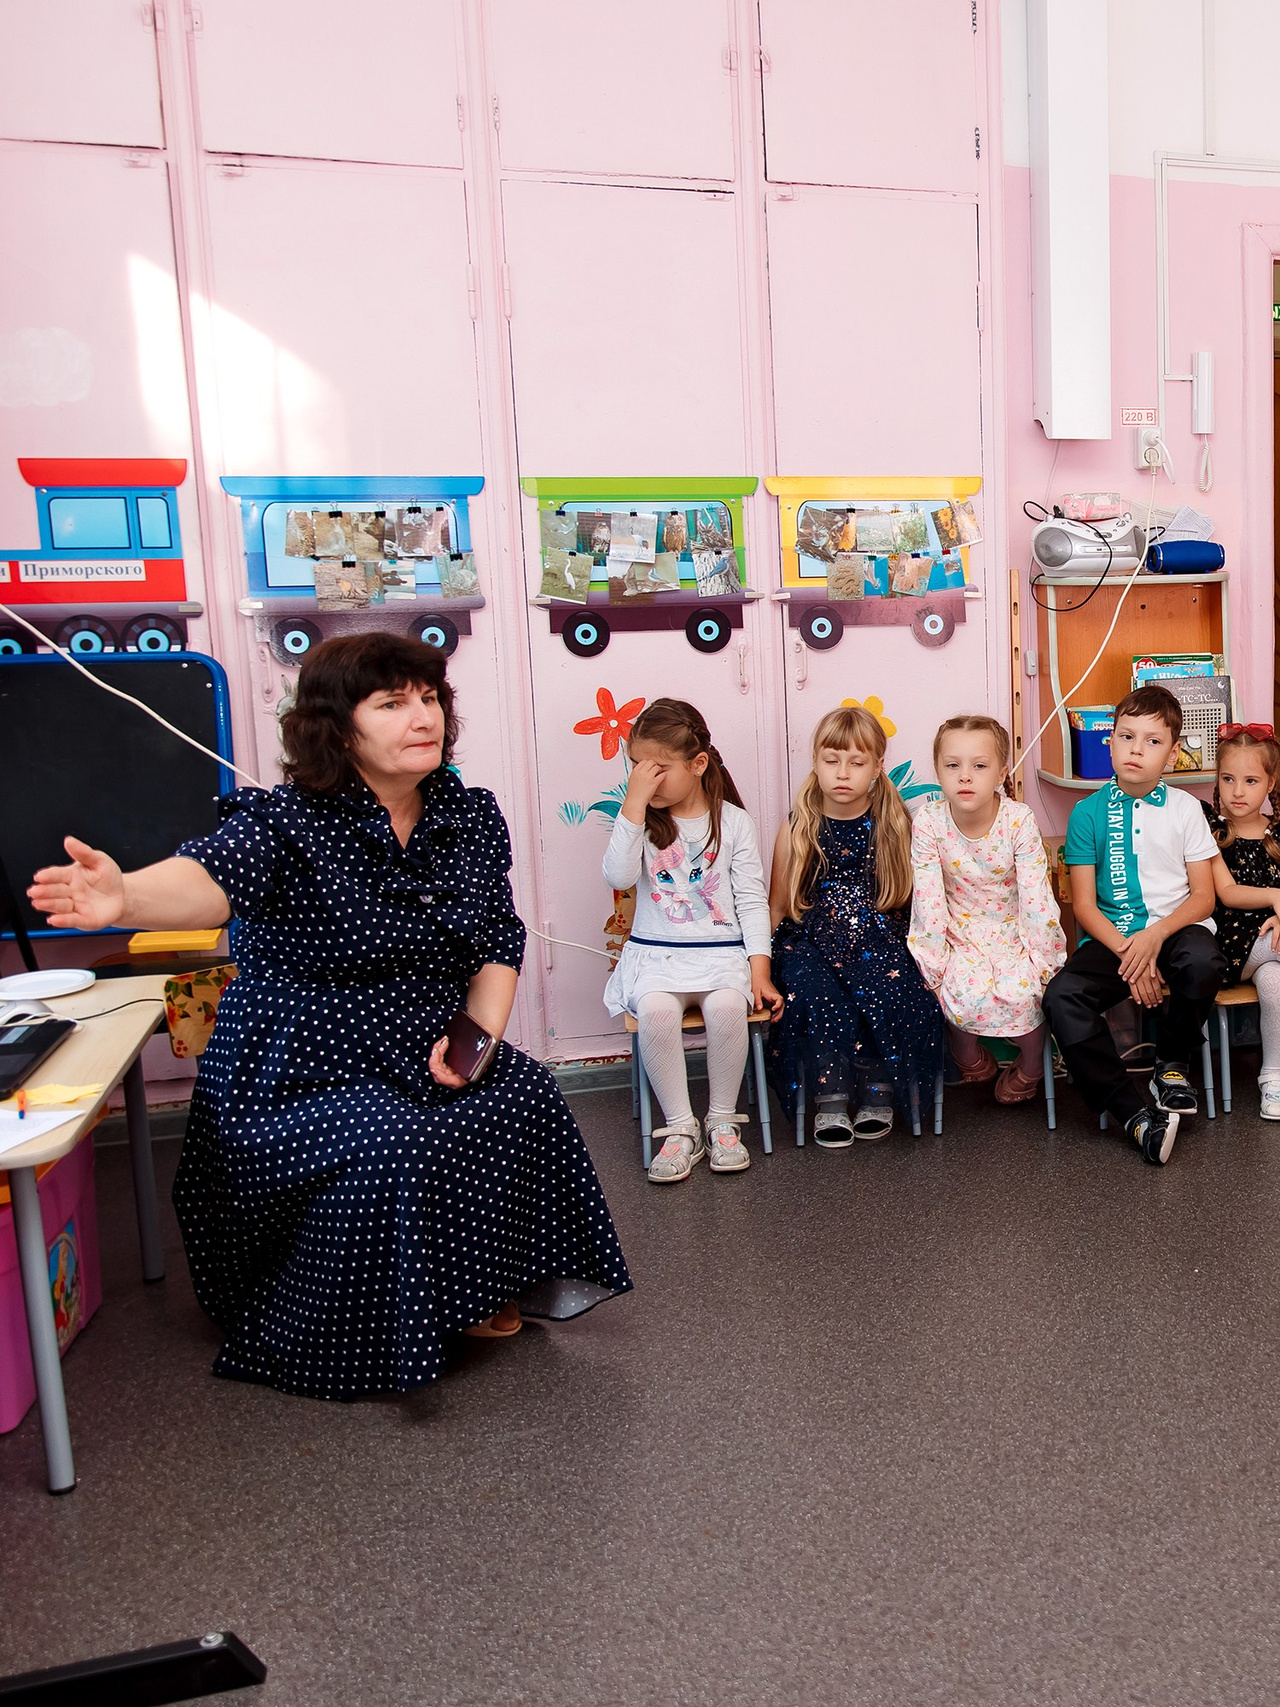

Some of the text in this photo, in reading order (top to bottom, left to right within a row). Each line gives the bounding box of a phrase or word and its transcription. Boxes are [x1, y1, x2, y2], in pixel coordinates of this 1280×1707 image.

[1124, 412, 1143, 421] 220
[23, 563, 143, 579] Приморского
[1107, 801, 1124, 829] STAY
[1109, 832, 1127, 886] PLUGGED
[1112, 889, 1129, 900] IN
